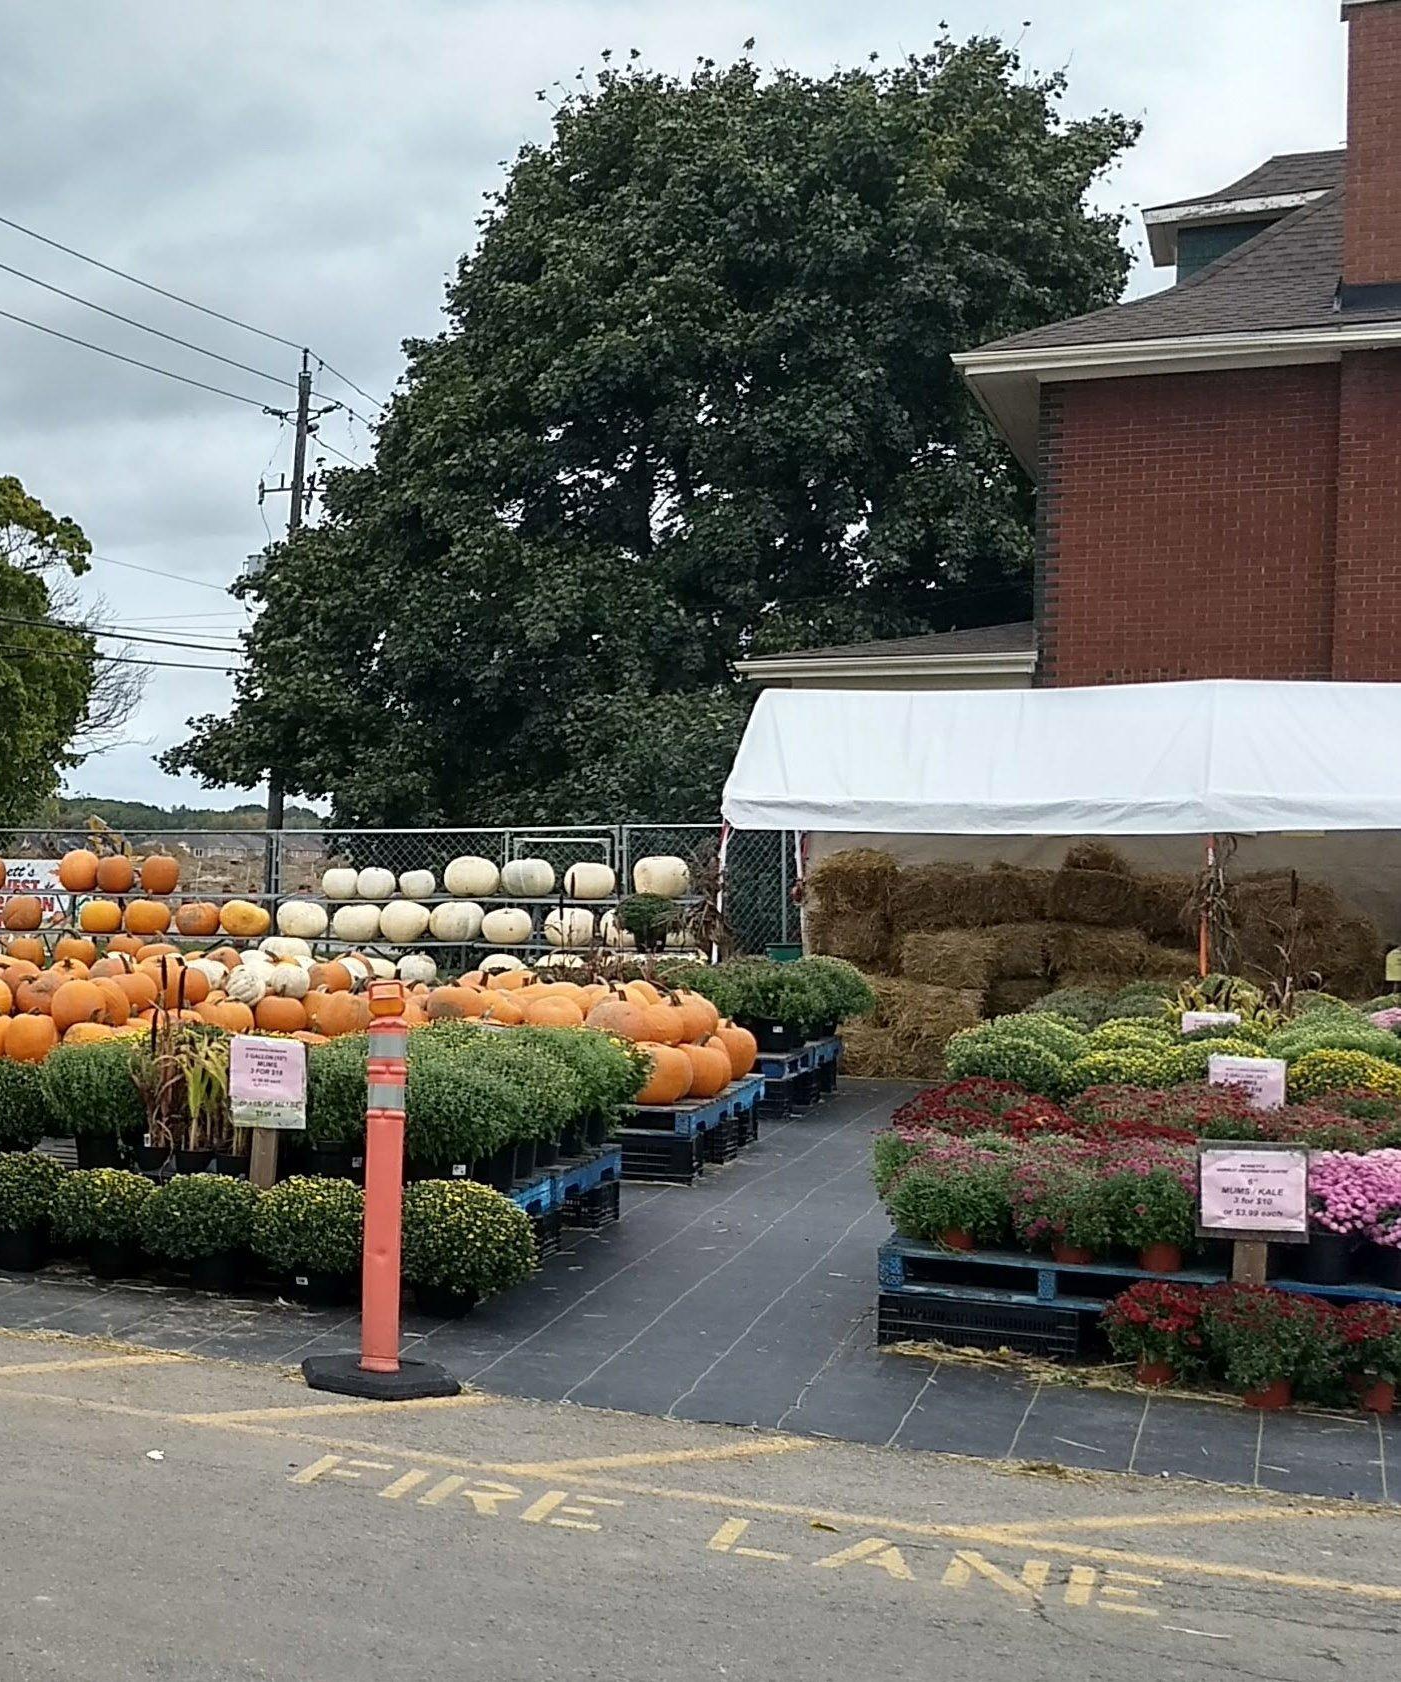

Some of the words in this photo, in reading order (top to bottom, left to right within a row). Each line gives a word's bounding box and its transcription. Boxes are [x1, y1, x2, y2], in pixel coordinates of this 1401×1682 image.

[6, 863, 35, 877] ett's
[1221, 1187, 1250, 1195] MUMS
[1258, 1188, 1284, 1196] KALE
[1256, 1197, 1273, 1205] $10
[1261, 1209, 1284, 1217] each
[286, 1455, 626, 1532] FIRE
[707, 1517, 1164, 1617] LANE
